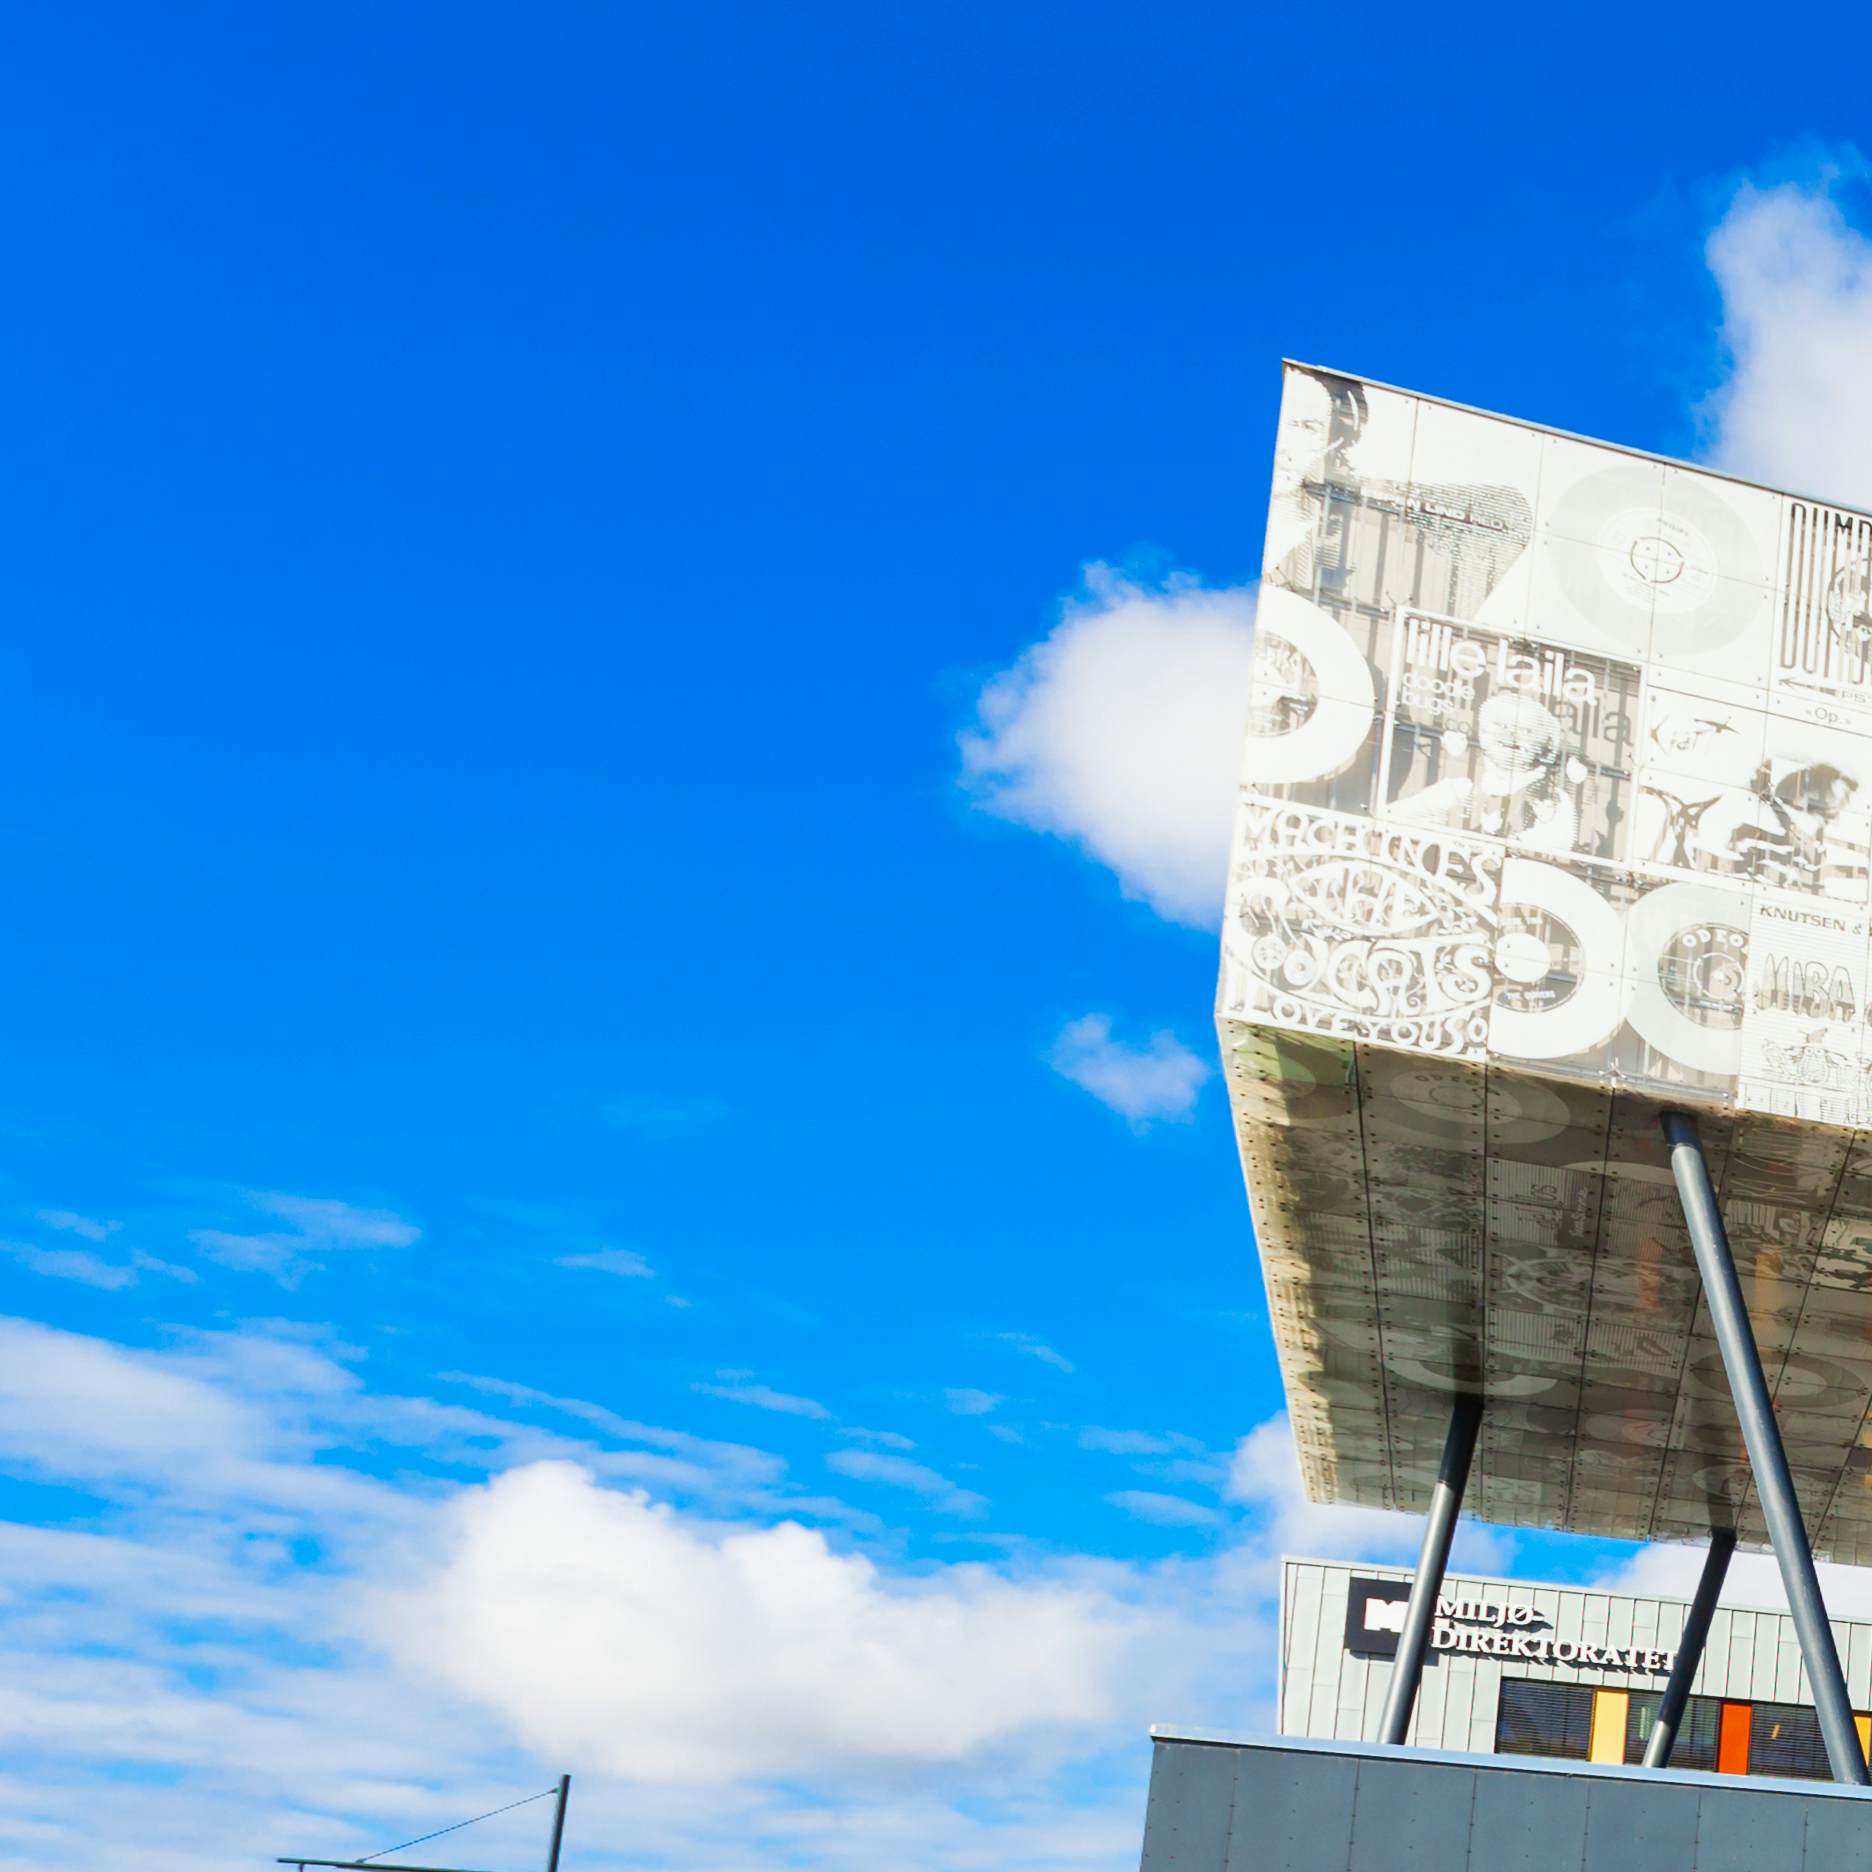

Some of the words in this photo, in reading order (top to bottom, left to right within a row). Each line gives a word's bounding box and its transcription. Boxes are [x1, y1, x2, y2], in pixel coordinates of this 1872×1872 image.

[1405, 617, 1487, 678] lille
[1496, 639, 1598, 703] laila
[1759, 903, 1847, 933] KNUTSEN
[1681, 928, 1747, 950] ODEO
[1434, 1595, 1546, 1625] MILJØ-
